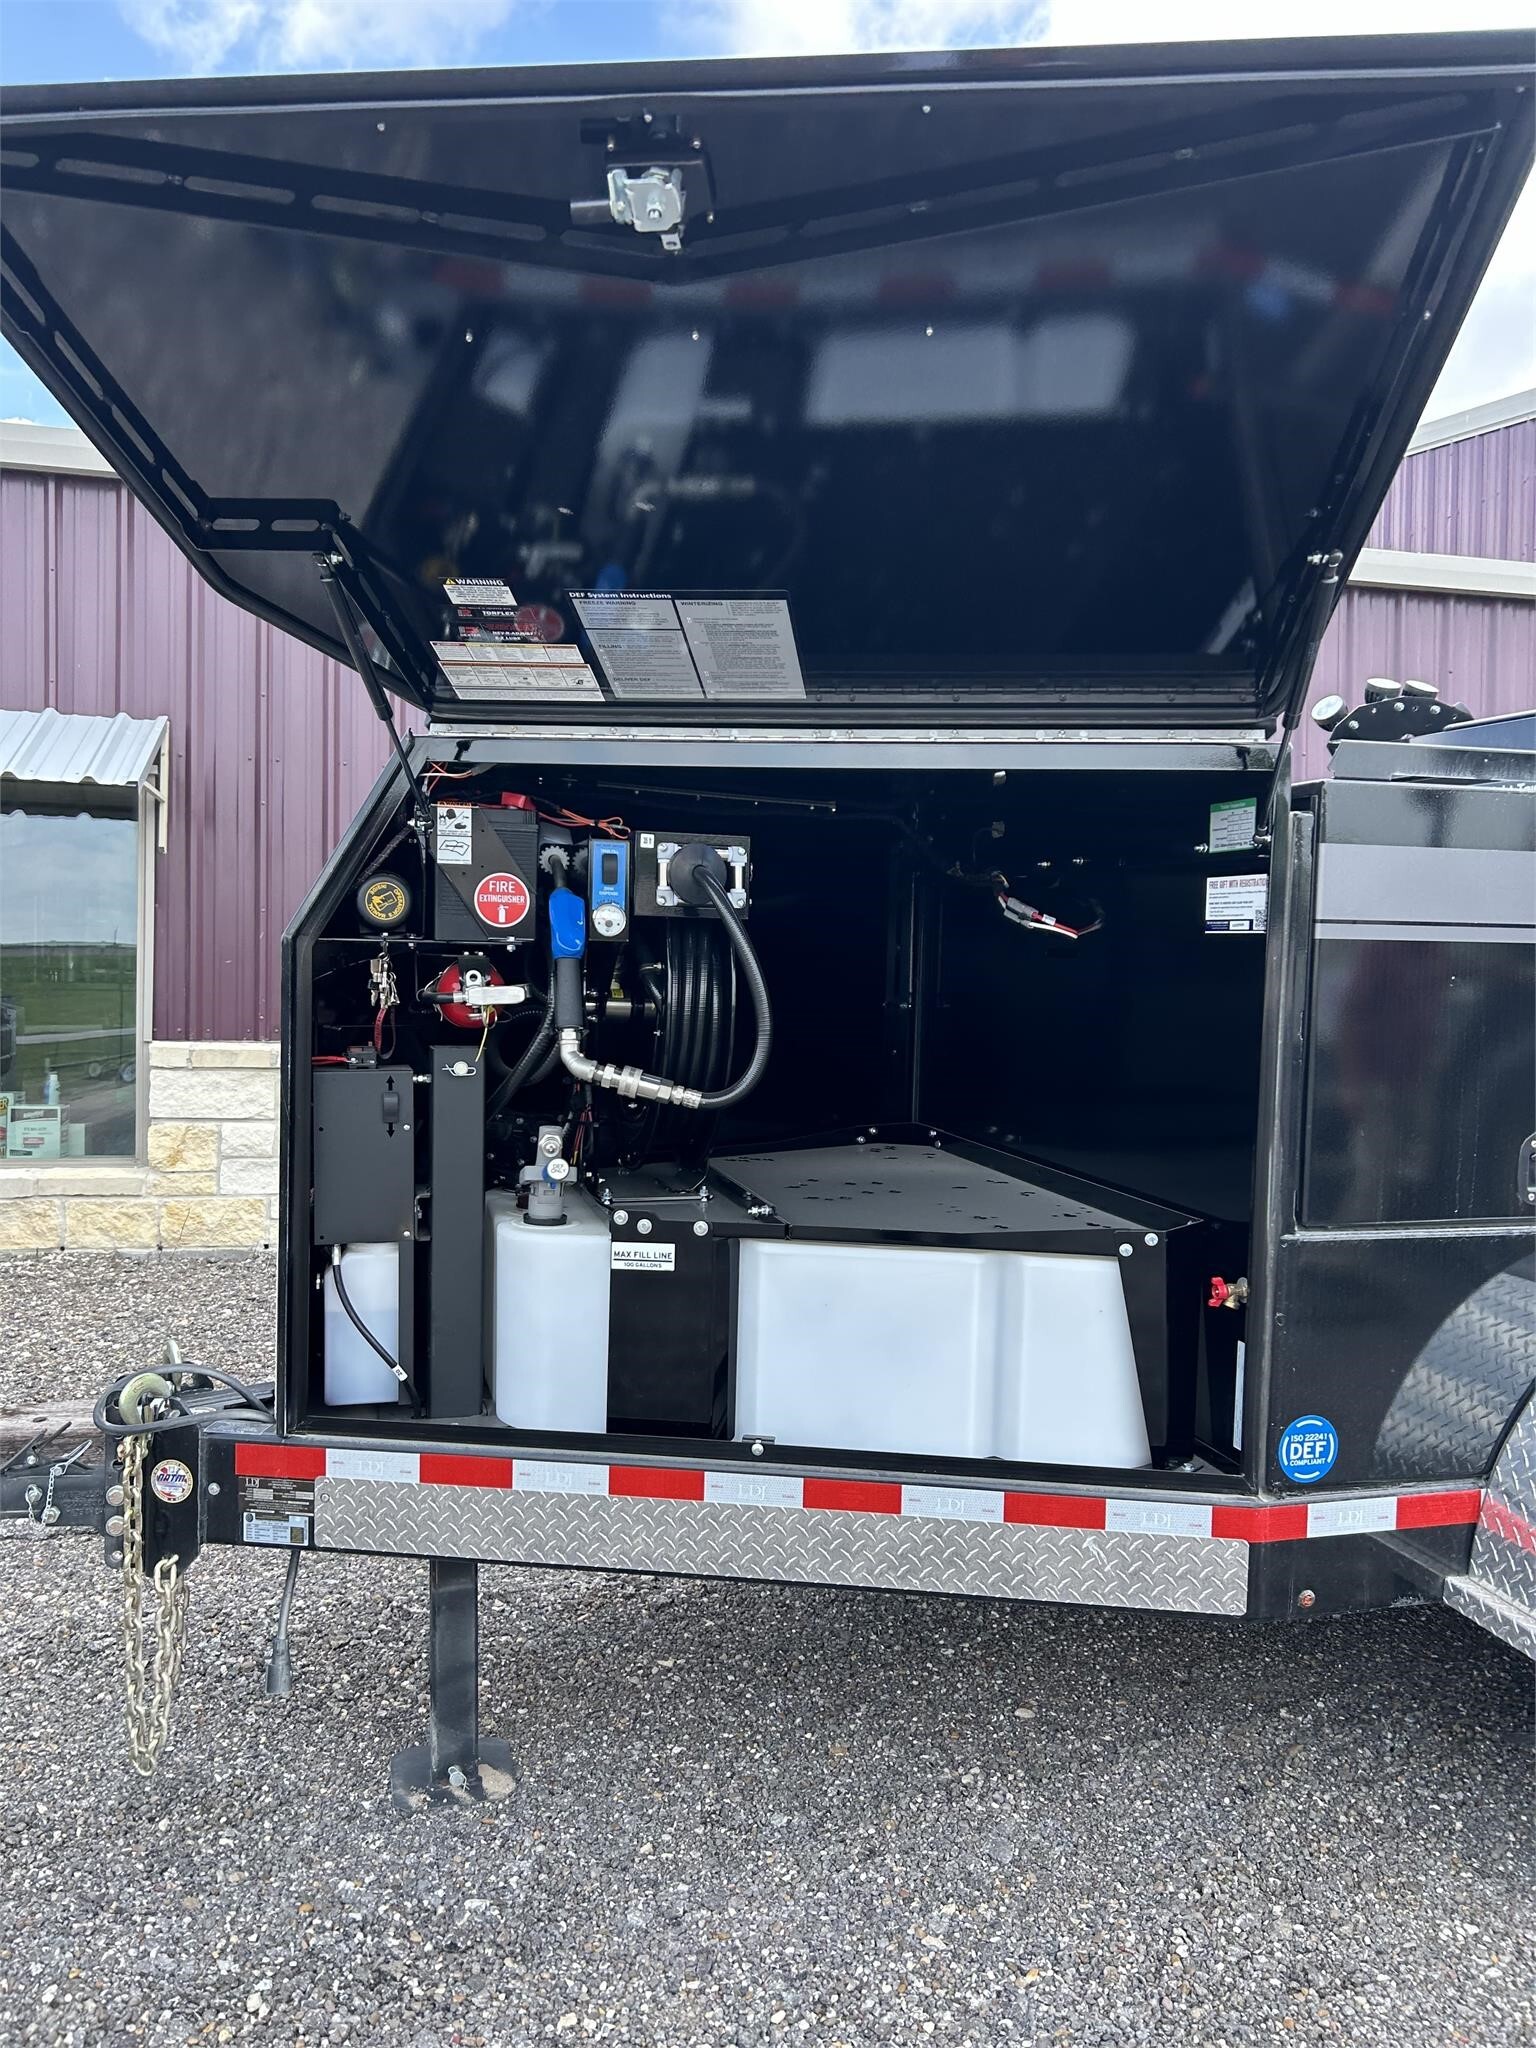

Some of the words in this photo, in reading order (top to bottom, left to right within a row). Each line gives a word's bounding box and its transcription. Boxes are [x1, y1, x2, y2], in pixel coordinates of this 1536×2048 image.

[489, 880, 516, 892] FIRE
[479, 894, 525, 904] EXTINGUISHER
[633, 1251, 651, 1259] FILL
[1291, 1434, 1304, 1442] ISO
[1305, 1433, 1327, 1441] 22241
[1290, 1441, 1327, 1460] DEF
[1290, 1458, 1326, 1466] COMPLIANT
